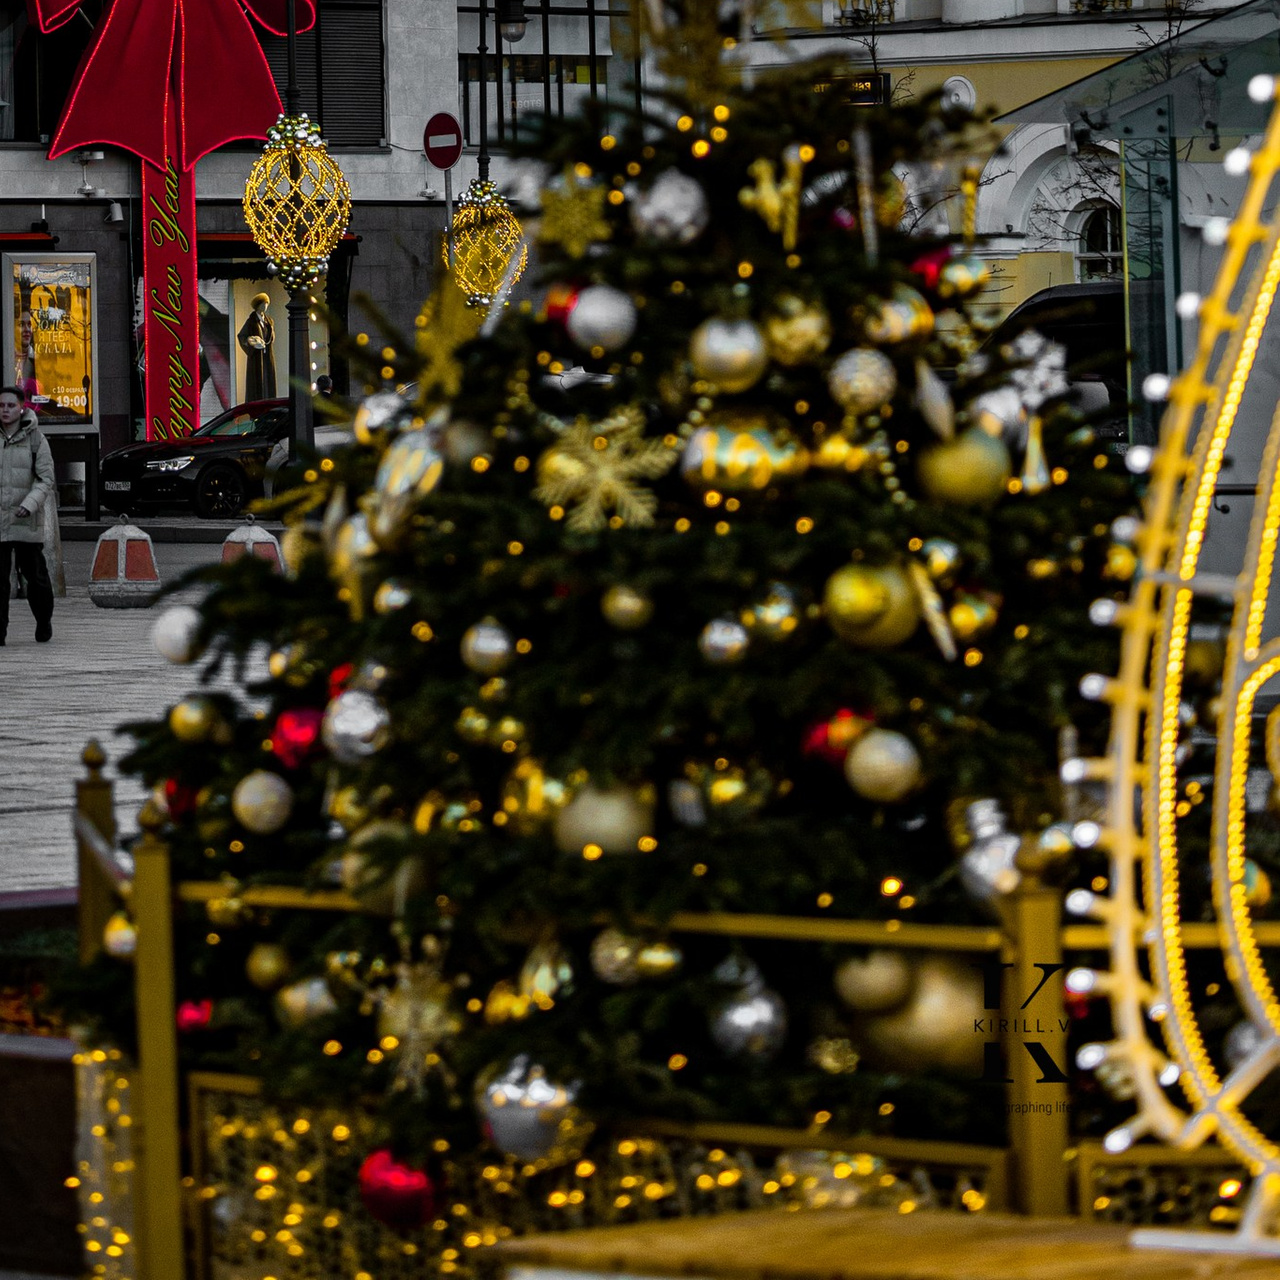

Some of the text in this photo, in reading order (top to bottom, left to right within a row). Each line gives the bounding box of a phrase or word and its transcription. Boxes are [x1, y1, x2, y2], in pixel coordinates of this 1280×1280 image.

[149, 156, 190, 254] Year
[150, 264, 183, 352] New
[47, 331, 71, 342] ТЕБЯ
[56, 395, 87, 407] 19:00
